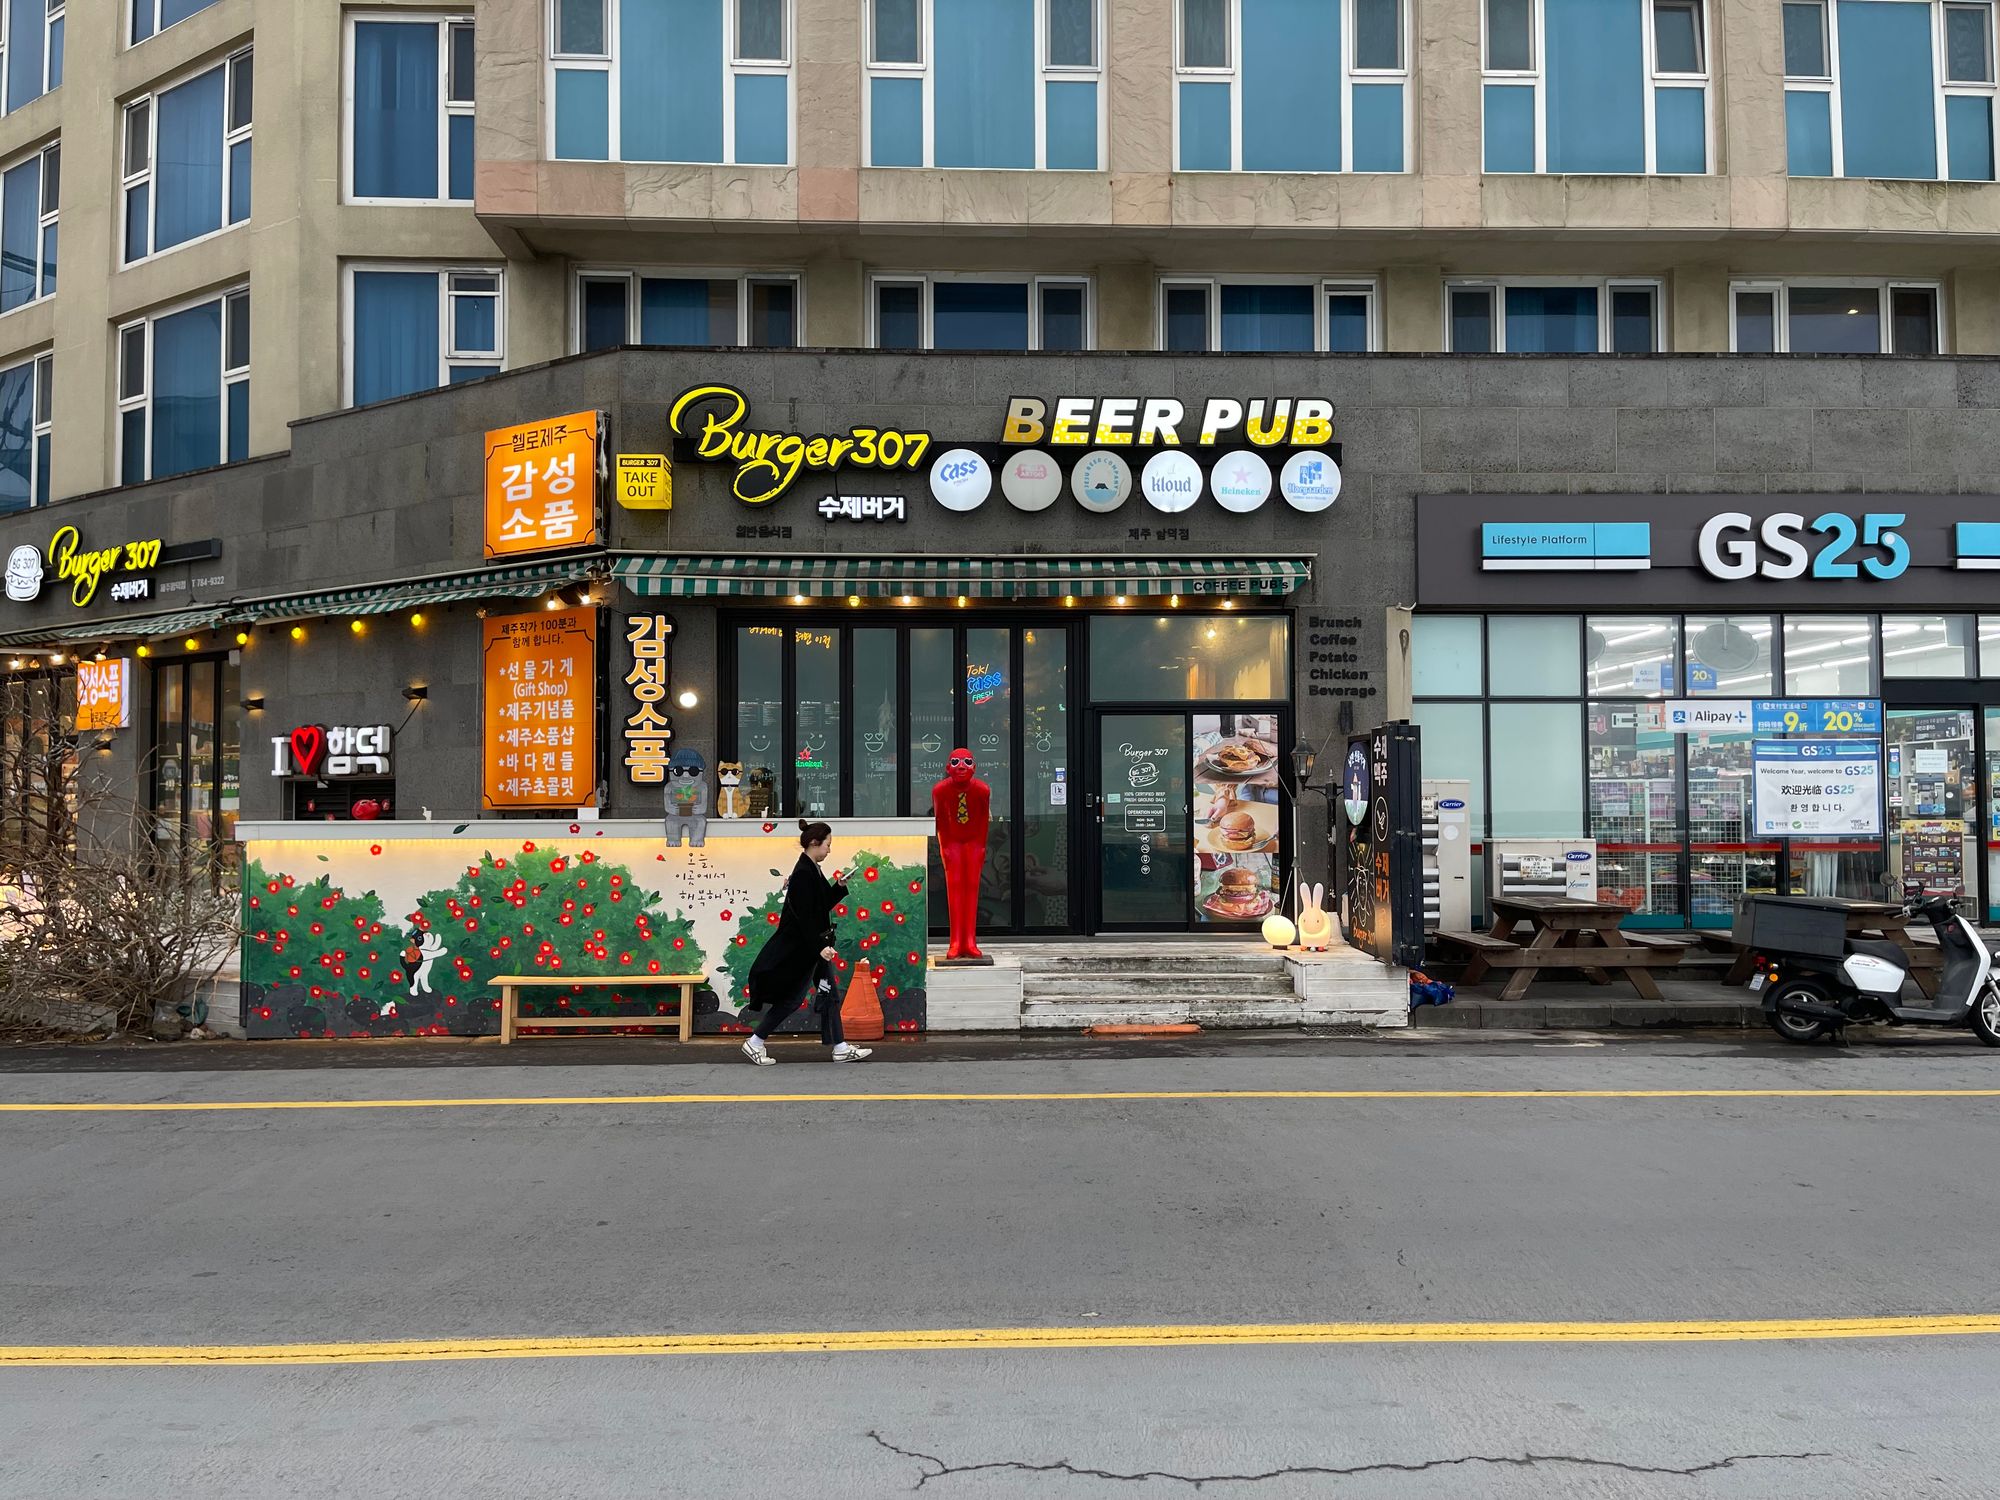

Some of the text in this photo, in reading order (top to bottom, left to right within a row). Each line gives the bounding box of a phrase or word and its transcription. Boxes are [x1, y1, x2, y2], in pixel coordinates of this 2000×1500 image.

[1002, 397, 1335, 445] BEER PUB
[512, 425, 567, 452] 헬로제주
[624, 472, 657, 483] TAKE
[627, 486, 655, 497] OUT
[1221, 487, 1261, 496] Heineken
[819, 496, 904, 520] 수제버거
[1128, 528, 1151, 540] 제주
[1492, 535, 1587, 546] Lifestyle Platform
[1699, 513, 1911, 579] GS25
[23, 558, 35, 569] 307
[49, 525, 161, 607] Burger 307
[111, 579, 148, 601] 수제버거
[1194, 580, 1246, 591] COFFEE
[501, 616, 577, 636] 제주작가 100분과
[1309, 616, 1362, 628] Brunch
[512, 636, 530, 648] 함께
[1310, 633, 1357, 645] Coffee
[1310, 651, 1357, 663] Potato
[1310, 669, 1368, 680] Chicken
[514, 680, 568, 699] (Gift Shop)
[1309, 685, 1377, 698] Beverage
[972, 690, 994, 702] FRESH
[506, 699, 574, 721] 제주기념품
[1784, 711, 1799, 732] 9
[506, 726, 574, 747] 제주소품샵
[326, 726, 390, 774] 함덕
[1119, 743, 1153, 763] Burger
[1374, 735, 1387, 759] 수제
[1801, 746, 1832, 756] GS25
[1845, 766, 1874, 775] GS25
[506, 777, 574, 797] 제주초콜릿
[1781, 785, 1854, 795] 欢迎光临 GS25
[1441, 800, 1463, 808] Carrier
